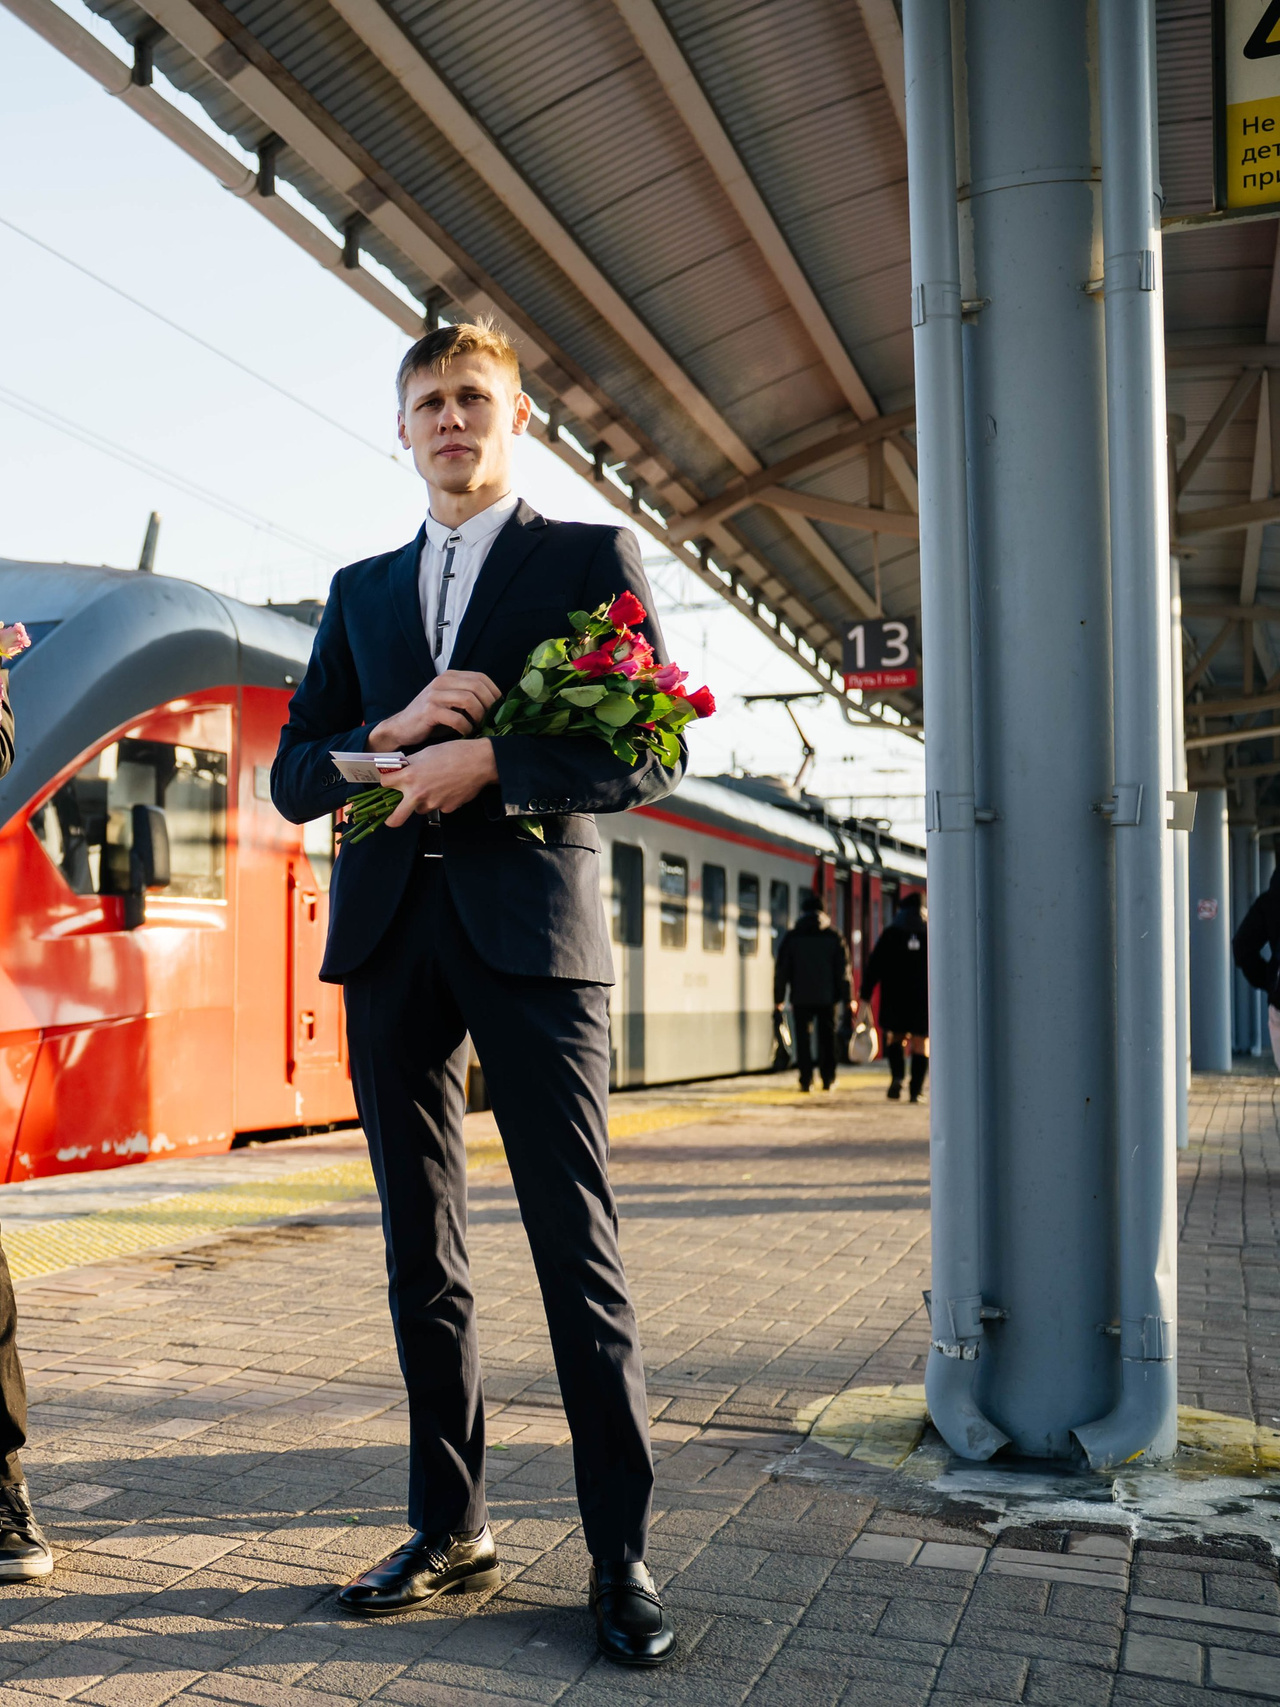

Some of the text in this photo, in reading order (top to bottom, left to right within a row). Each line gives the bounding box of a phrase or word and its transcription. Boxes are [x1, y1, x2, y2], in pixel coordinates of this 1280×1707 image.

[1243, 116, 1275, 136] Не
[1241, 143, 1280, 165] дет
[847, 621, 910, 669] 13
